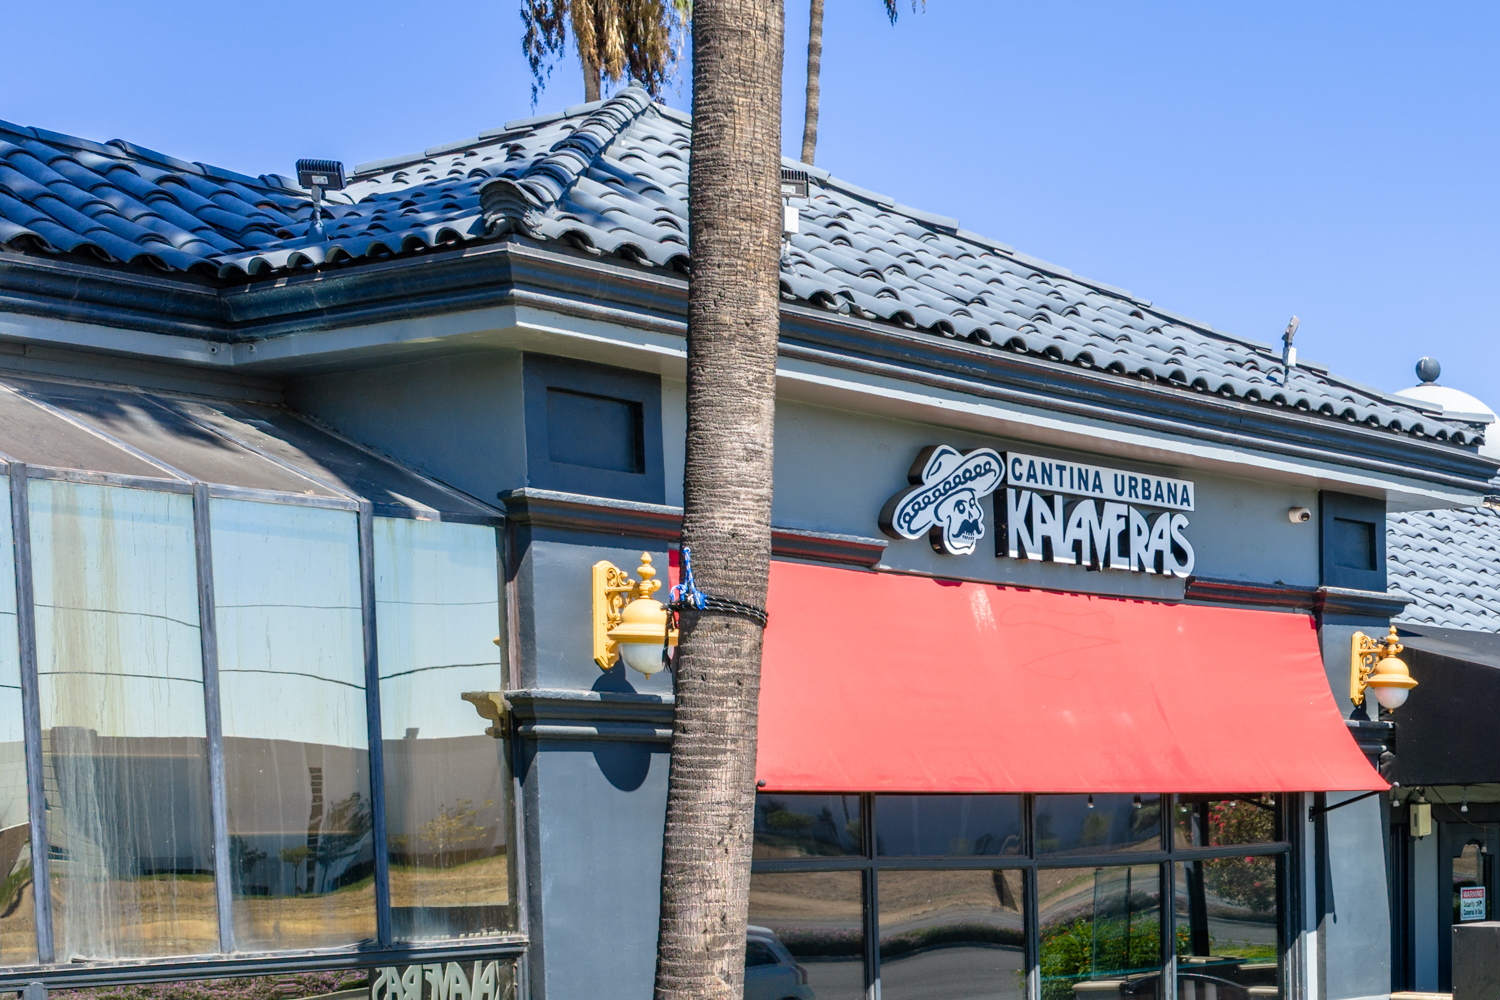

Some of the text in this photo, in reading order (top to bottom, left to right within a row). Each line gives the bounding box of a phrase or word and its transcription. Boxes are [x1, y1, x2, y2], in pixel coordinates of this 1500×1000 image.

[1011, 457, 1192, 508] CANTINA URBANA
[1007, 488, 1195, 578] KALAVERAS
[1463, 890, 1483, 898] WARNING
